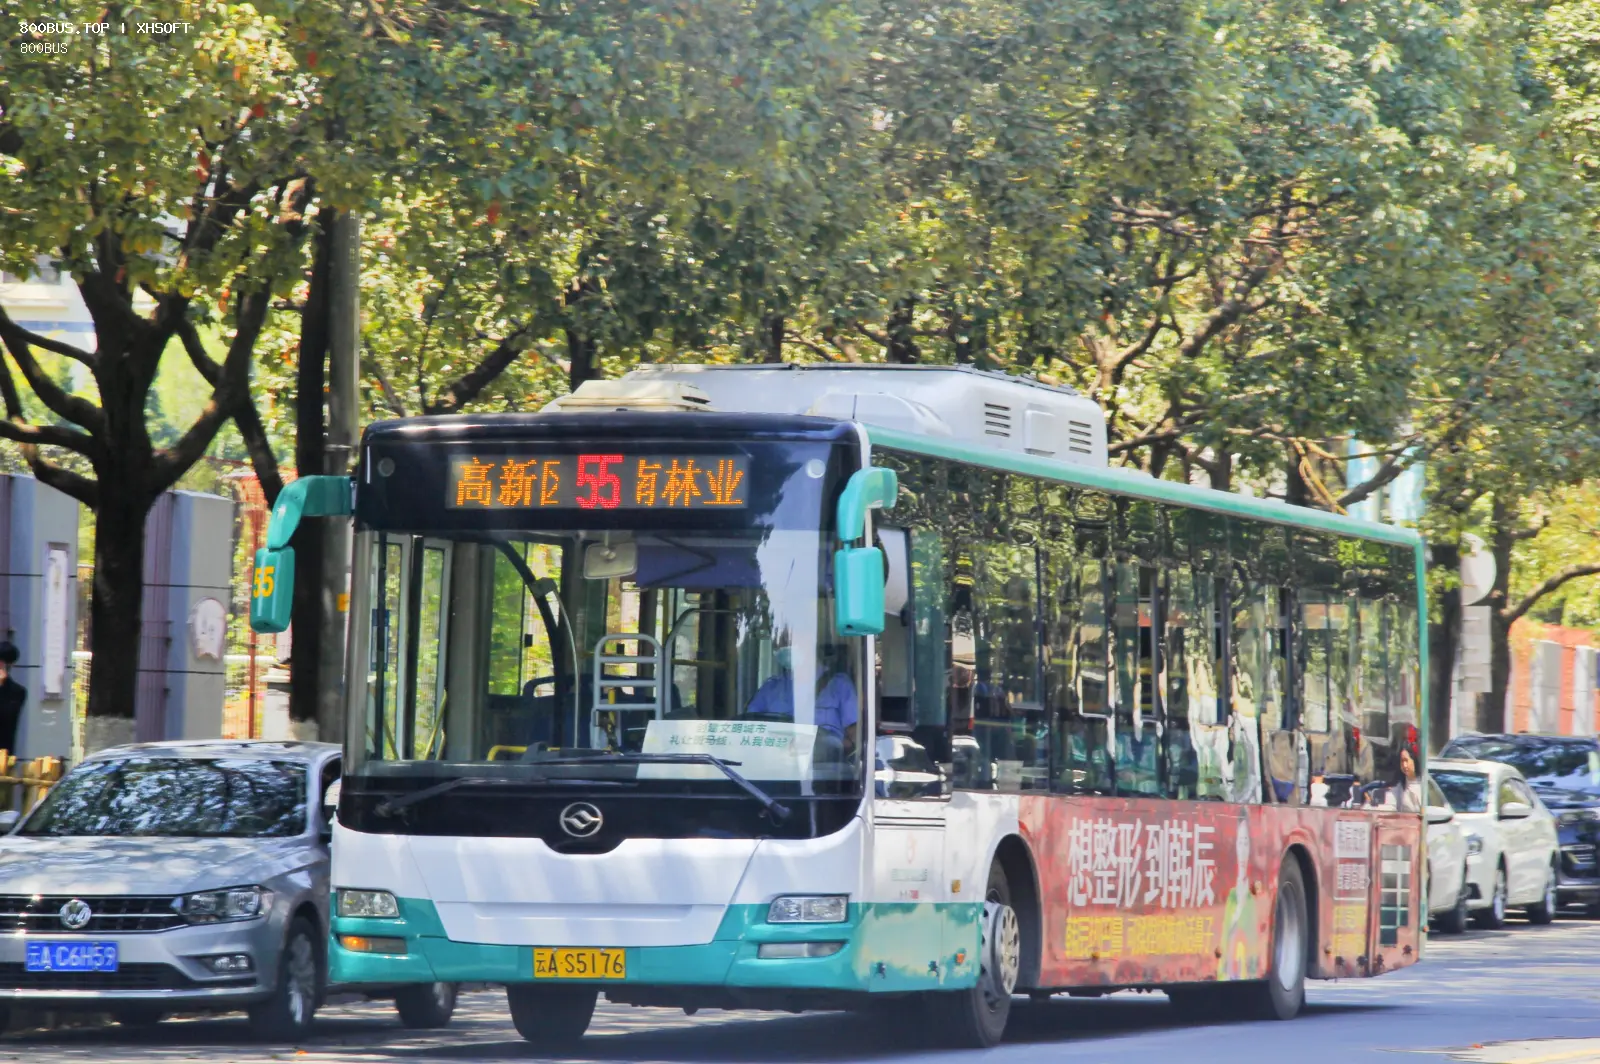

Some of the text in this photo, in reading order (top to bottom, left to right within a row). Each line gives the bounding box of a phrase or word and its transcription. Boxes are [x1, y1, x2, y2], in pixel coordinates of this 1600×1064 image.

[575, 454, 625, 509] 55
[253, 566, 275, 598] 55
[1067, 816, 1216, 909] 想整形到韩辰
